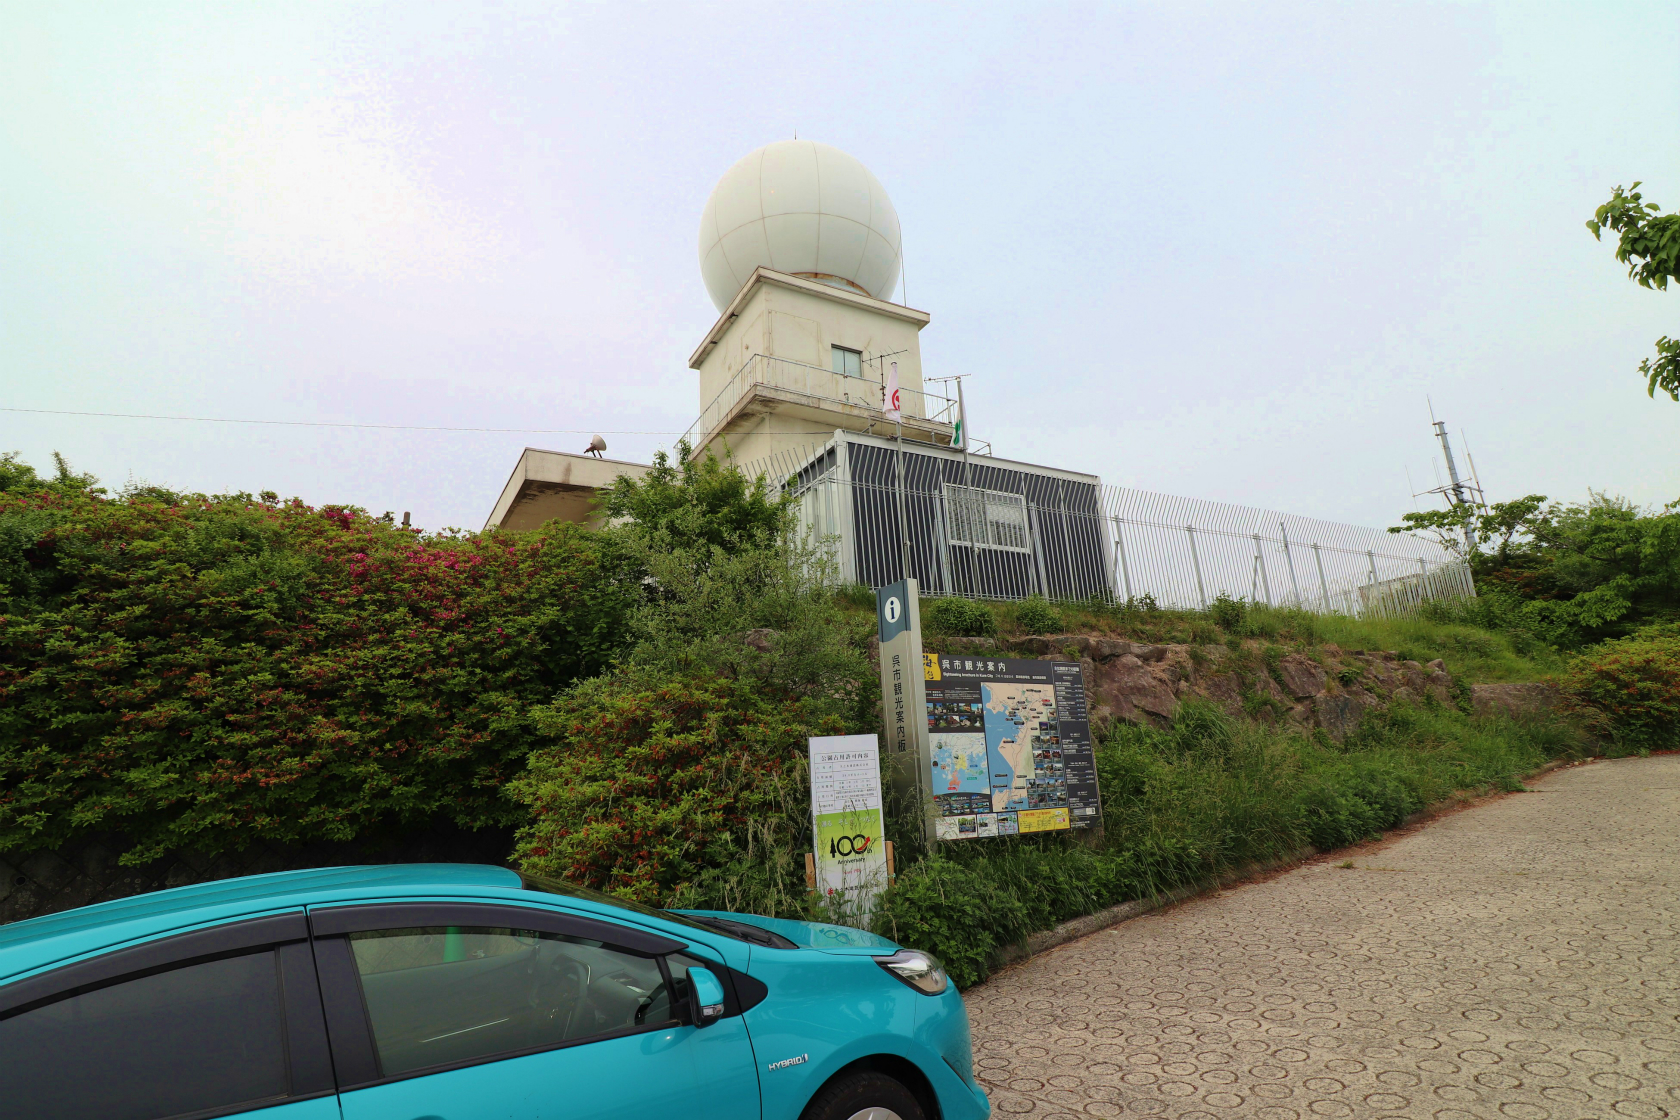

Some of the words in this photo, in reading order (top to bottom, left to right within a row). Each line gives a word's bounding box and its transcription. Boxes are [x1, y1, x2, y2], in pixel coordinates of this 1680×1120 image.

[941, 659, 1006, 672] 呉市観光案内
[891, 654, 907, 752] 呉市観光案内板
[768, 1056, 803, 1072] HYBRID
